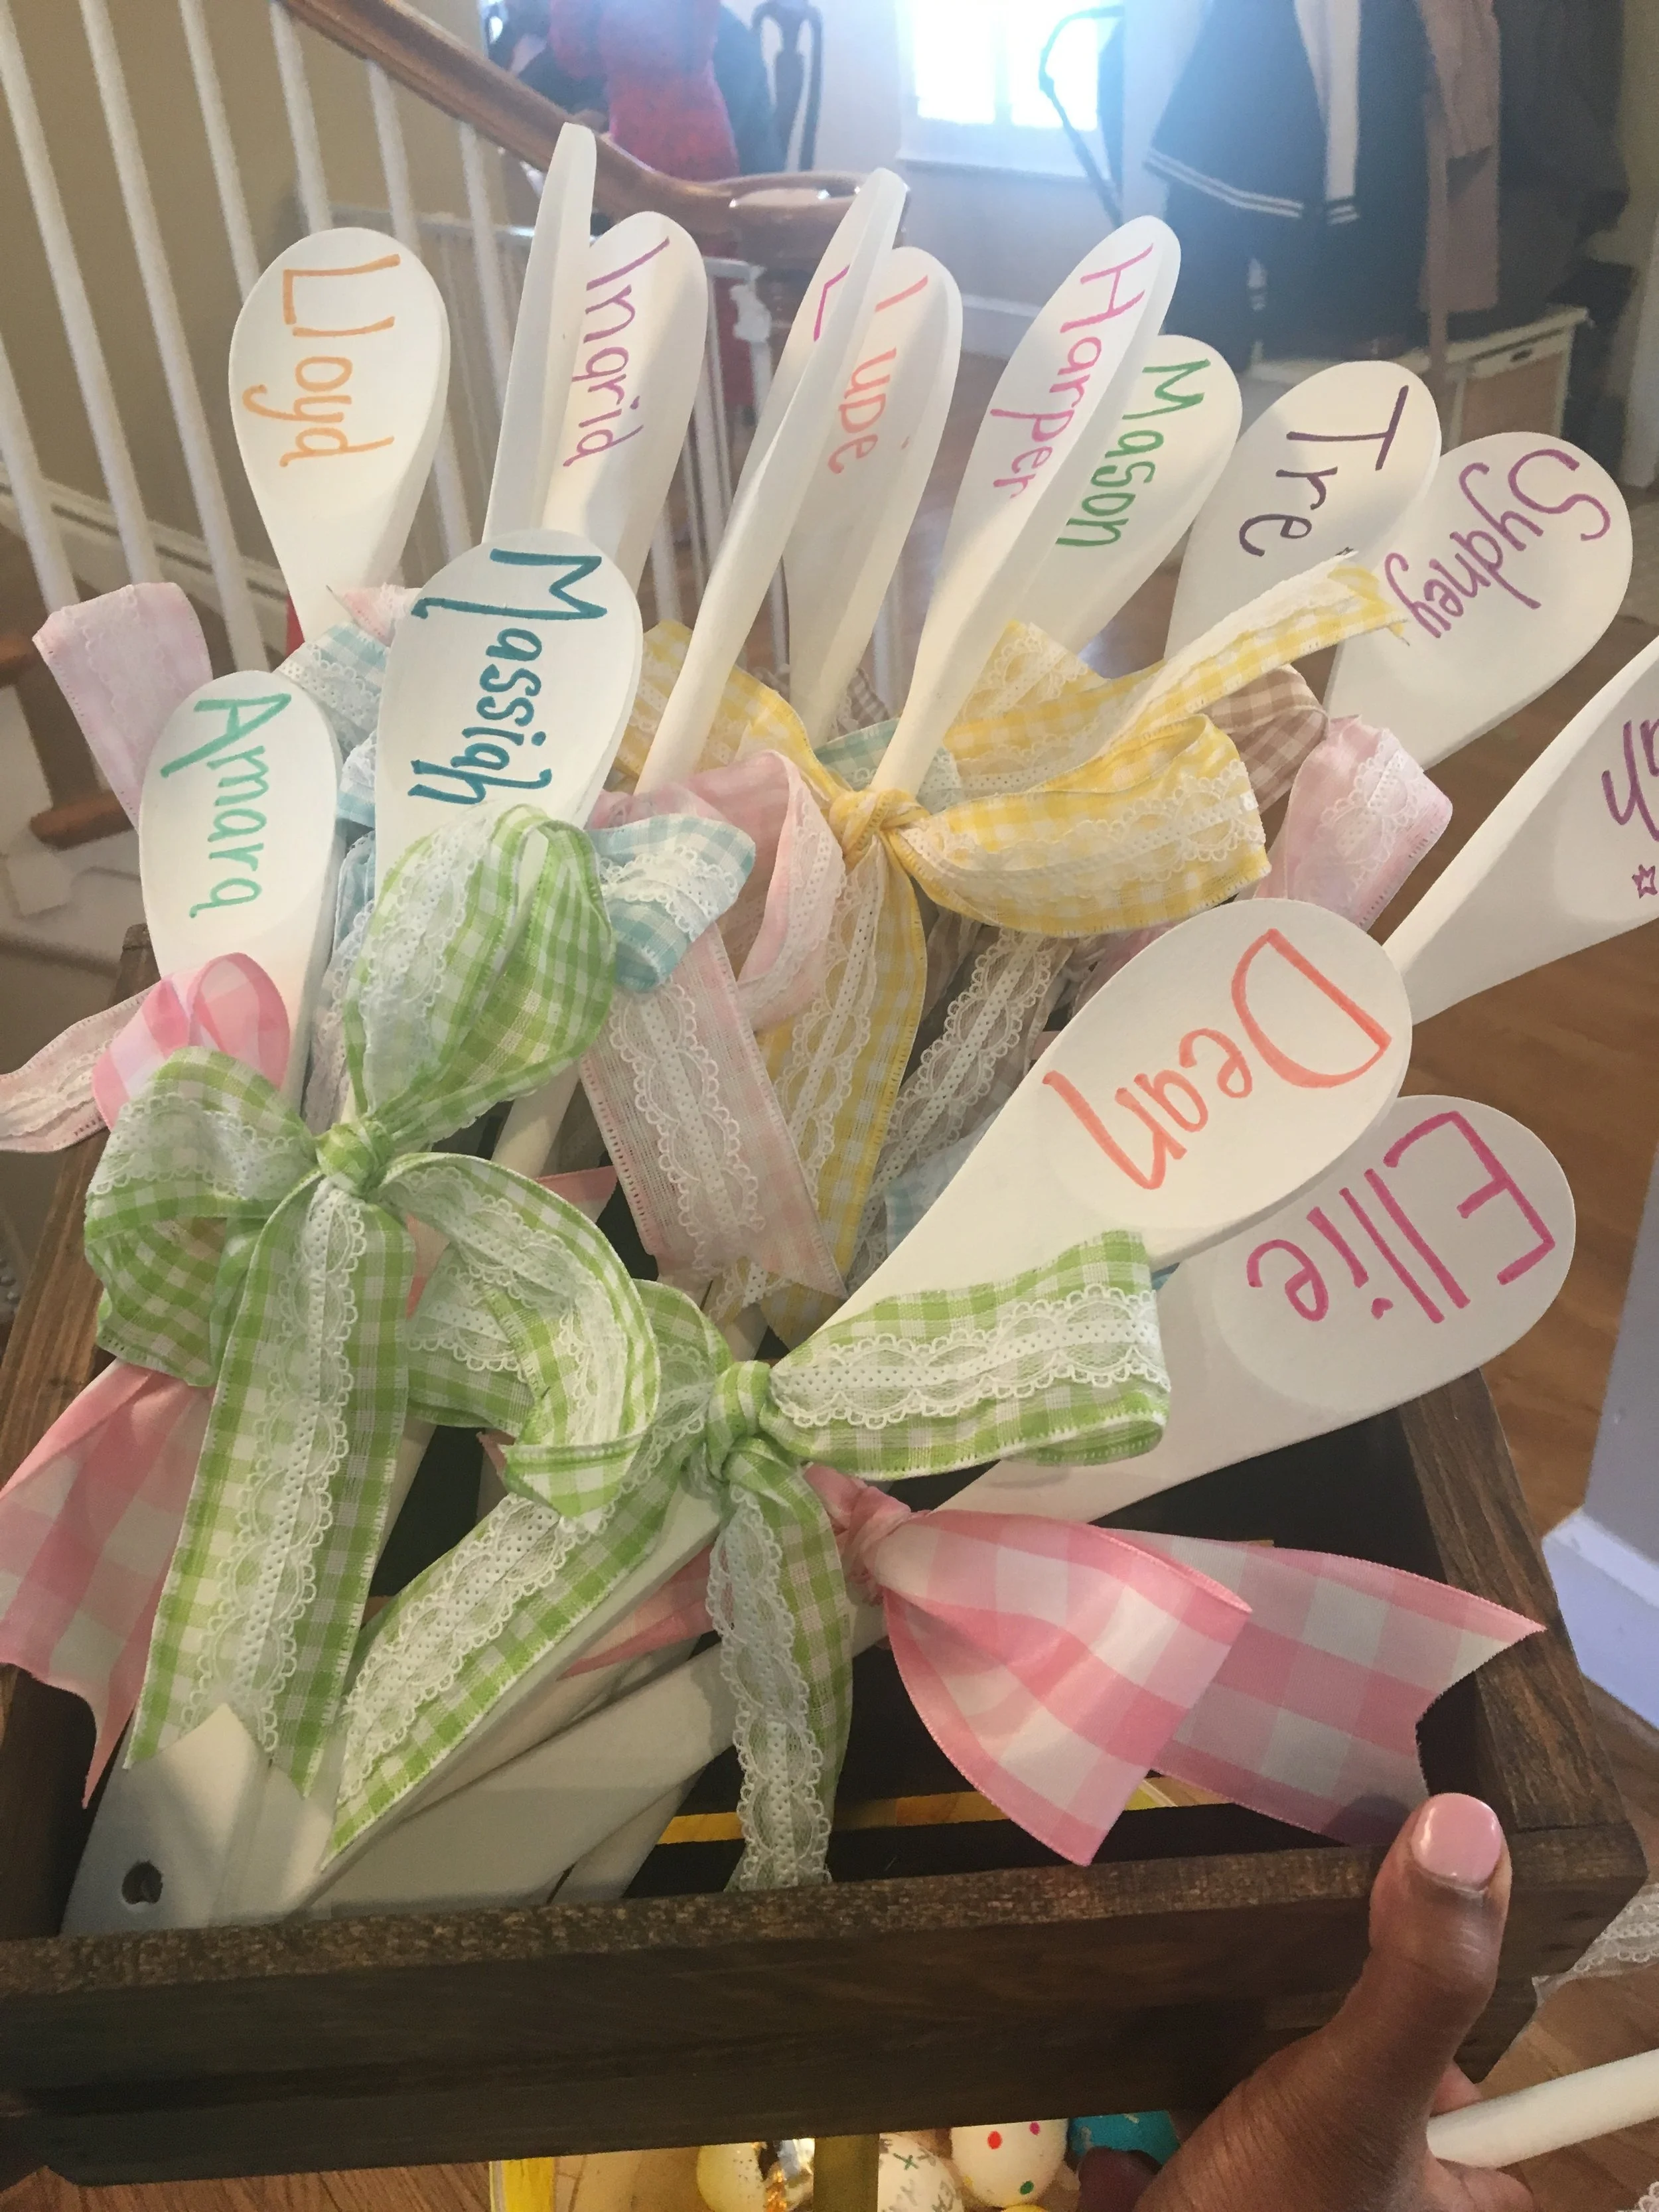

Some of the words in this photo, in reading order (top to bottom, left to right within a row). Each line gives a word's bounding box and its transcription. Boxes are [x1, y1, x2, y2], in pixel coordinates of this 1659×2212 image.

[243, 254, 401, 468] Lloyd
[563, 237, 670, 468] Ingrid
[990, 243, 1153, 502] Harper
[1055, 358, 1212, 547] Mason
[1238, 385, 1410, 557] Tre
[1384, 447, 1611, 638] Sydney
[407, 548, 609, 805] Massiah
[160, 694, 292, 919] Amara
[1042, 927, 1393, 1191] Dean
[1246, 1110, 1557, 1325] Ellie
